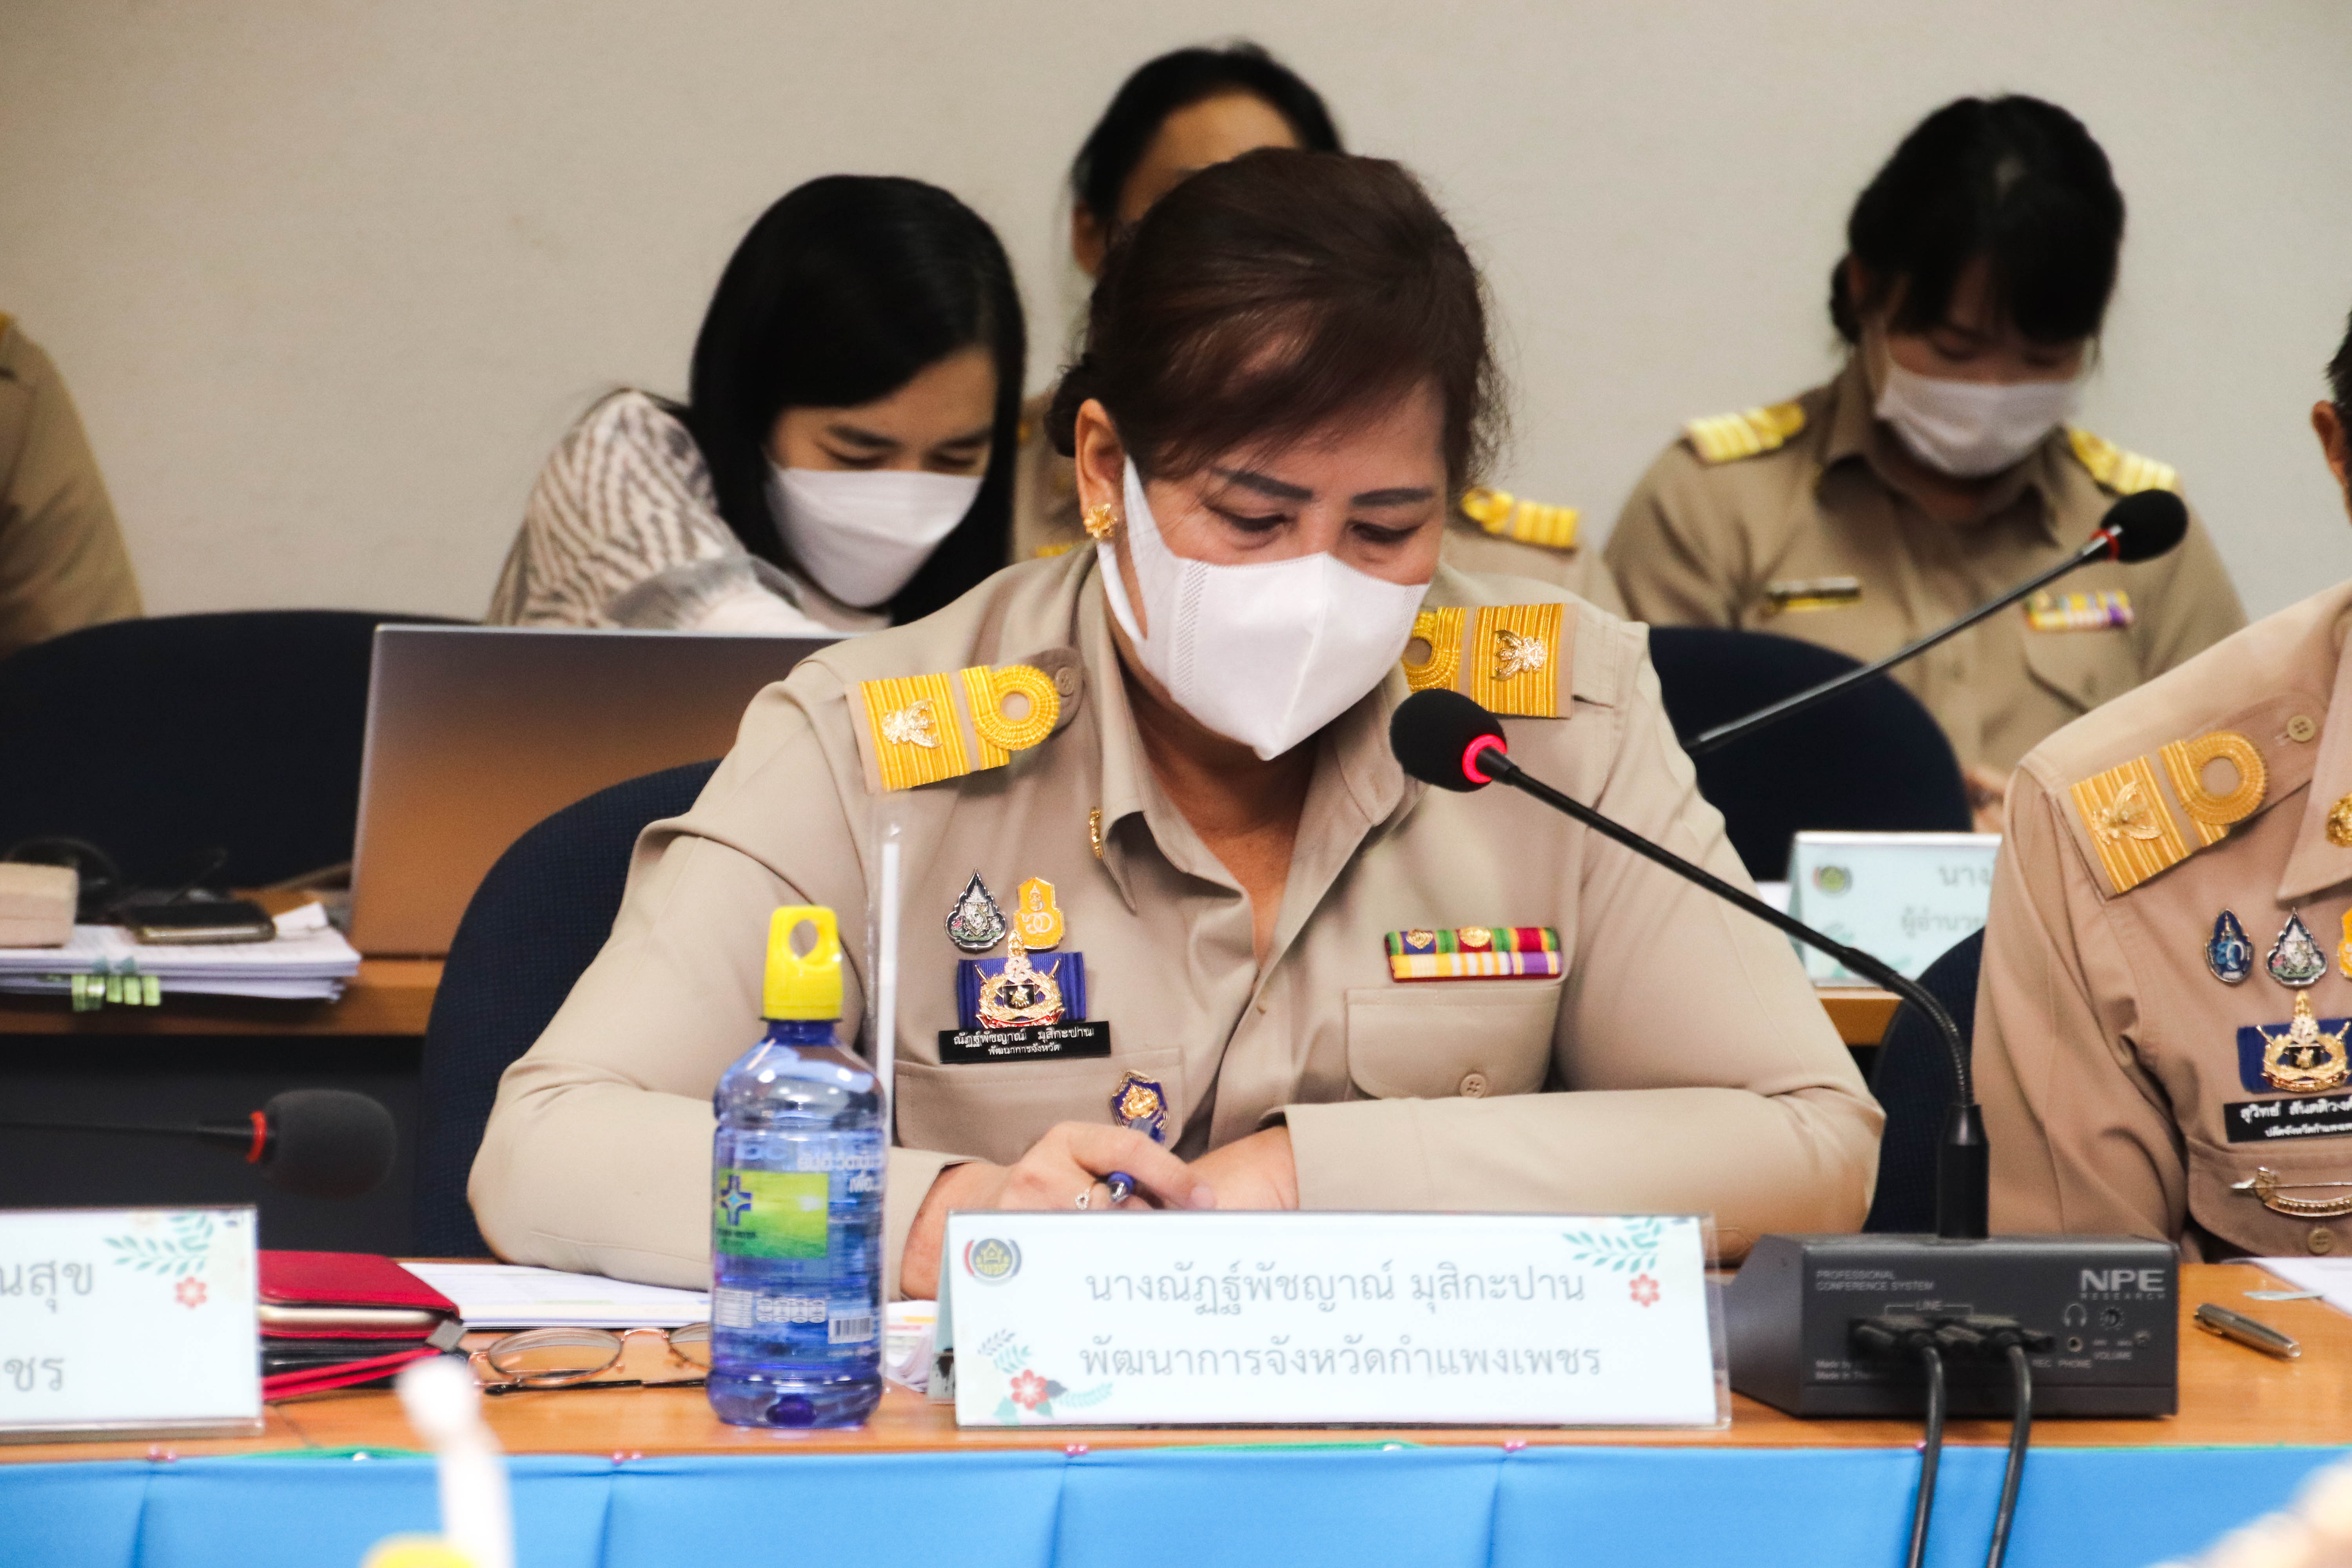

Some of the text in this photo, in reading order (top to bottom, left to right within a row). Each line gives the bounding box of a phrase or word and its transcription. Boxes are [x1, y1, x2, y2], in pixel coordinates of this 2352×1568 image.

[1037, 1026, 1094, 1044] มุสิกะปาน
[988, 1043, 1062, 1056] พัฒนาการจังหวัด
[1816, 1270, 1895, 1280] PROFESSIONAL
[2080, 1269, 2166, 1292] NPE
[1085, 1259, 1585, 1316] นางณัฏฐ์พัชญาณ์ มุสิกะปาน
[1816, 1280, 1935, 1291] CONFERENCE SYSTEM
[1079, 1334, 1601, 1376] พัฒนาการจังหวัดกำแพงเพชร
[2058, 1359, 2092, 1368] PHONE
